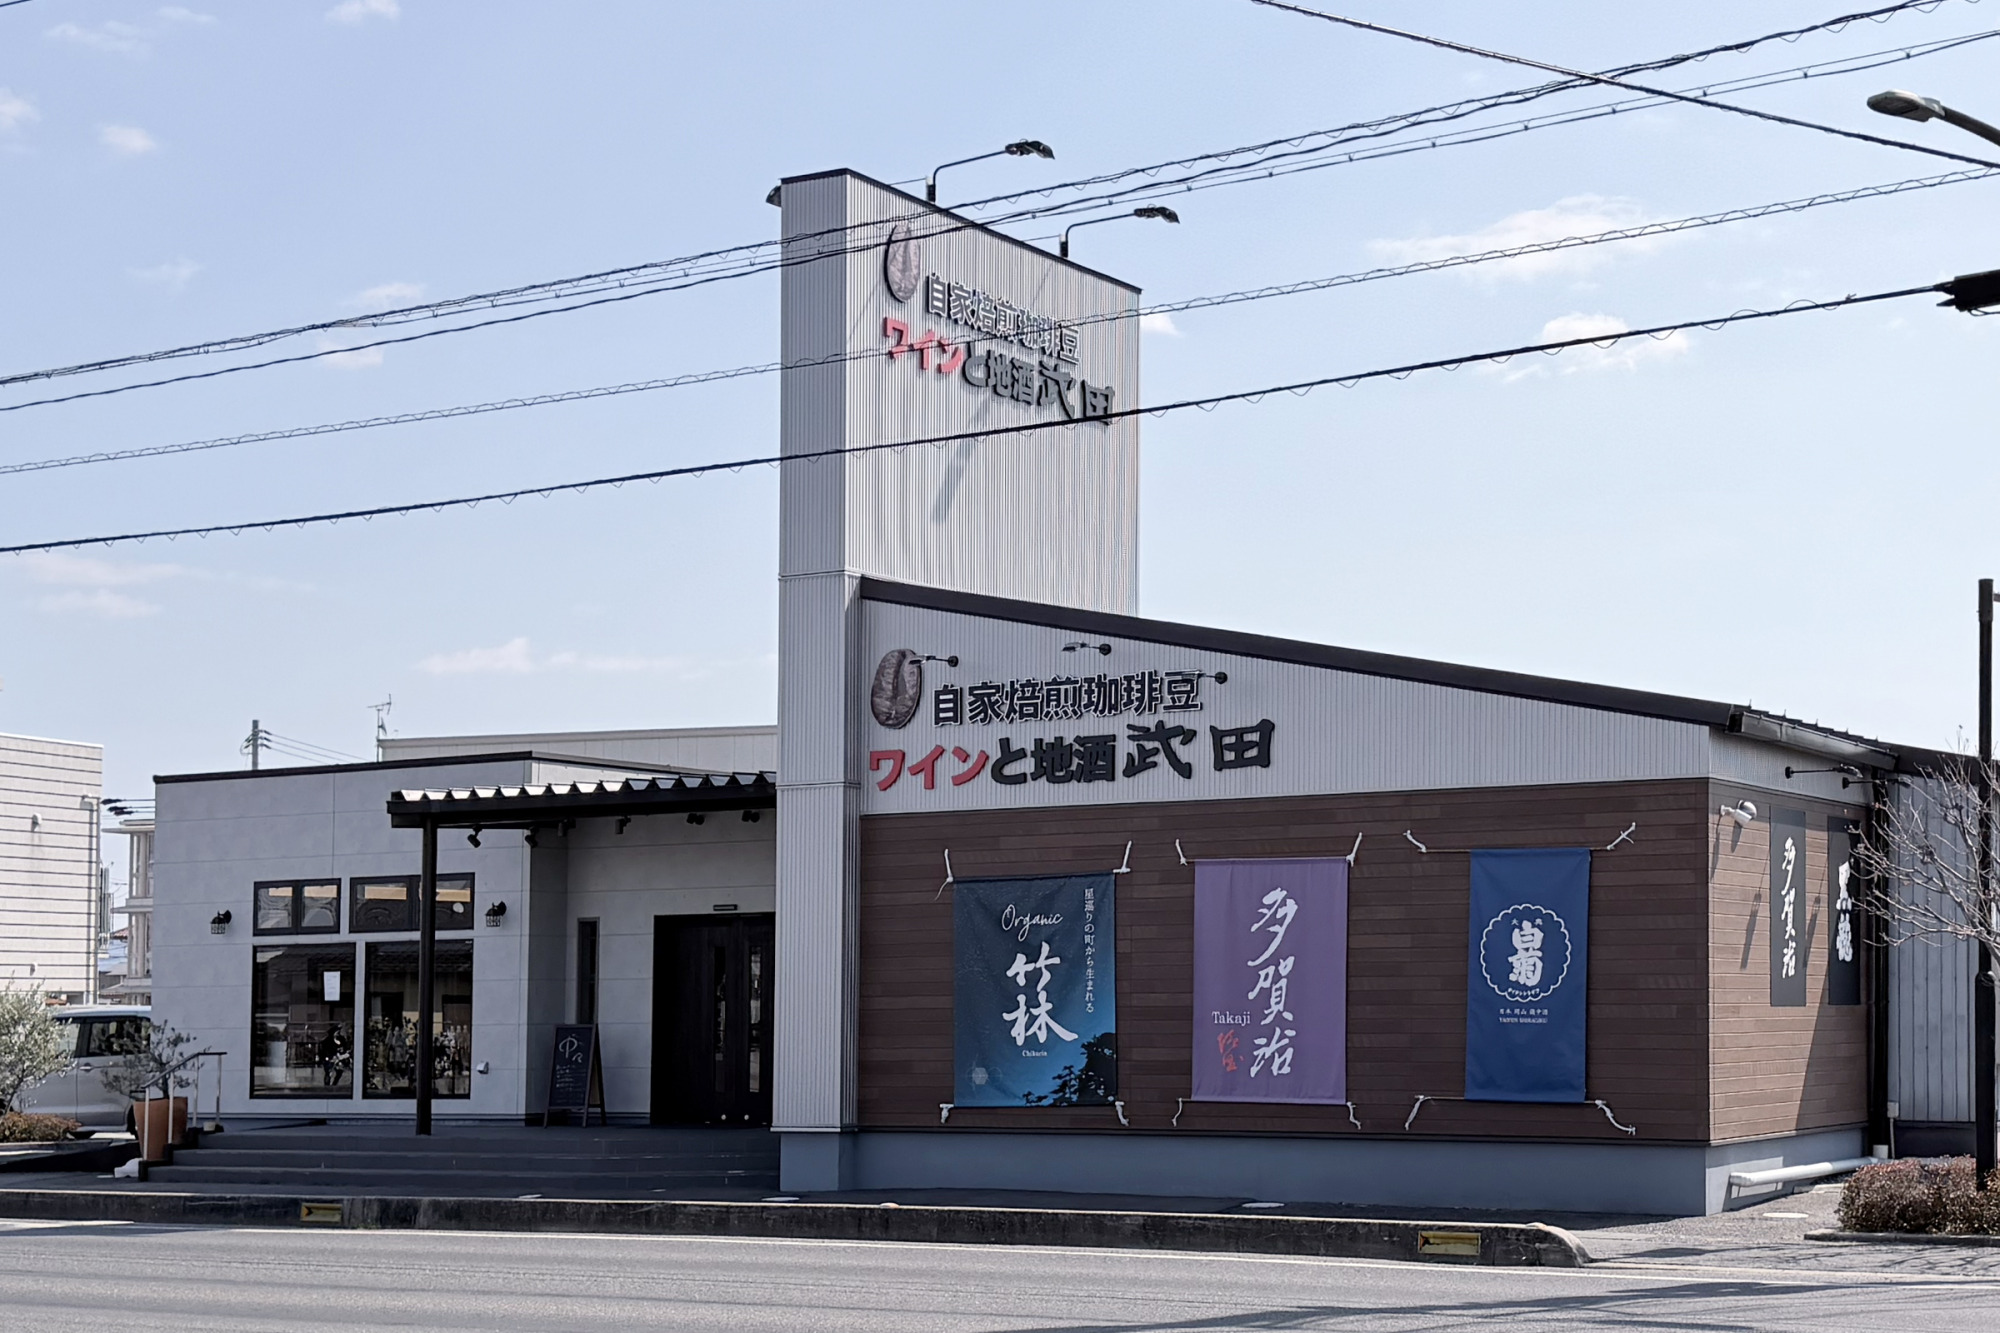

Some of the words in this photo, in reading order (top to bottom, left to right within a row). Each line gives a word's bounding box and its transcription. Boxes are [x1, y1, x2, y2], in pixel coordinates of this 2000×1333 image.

[933, 669, 1202, 727] 自家焙煎珈琲豆
[1001, 904, 1064, 942] Organic
[1002, 941, 1079, 1047] 竹林
[1247, 887, 1298, 1078] 多賀治
[1211, 1011, 1251, 1027] Takaji
